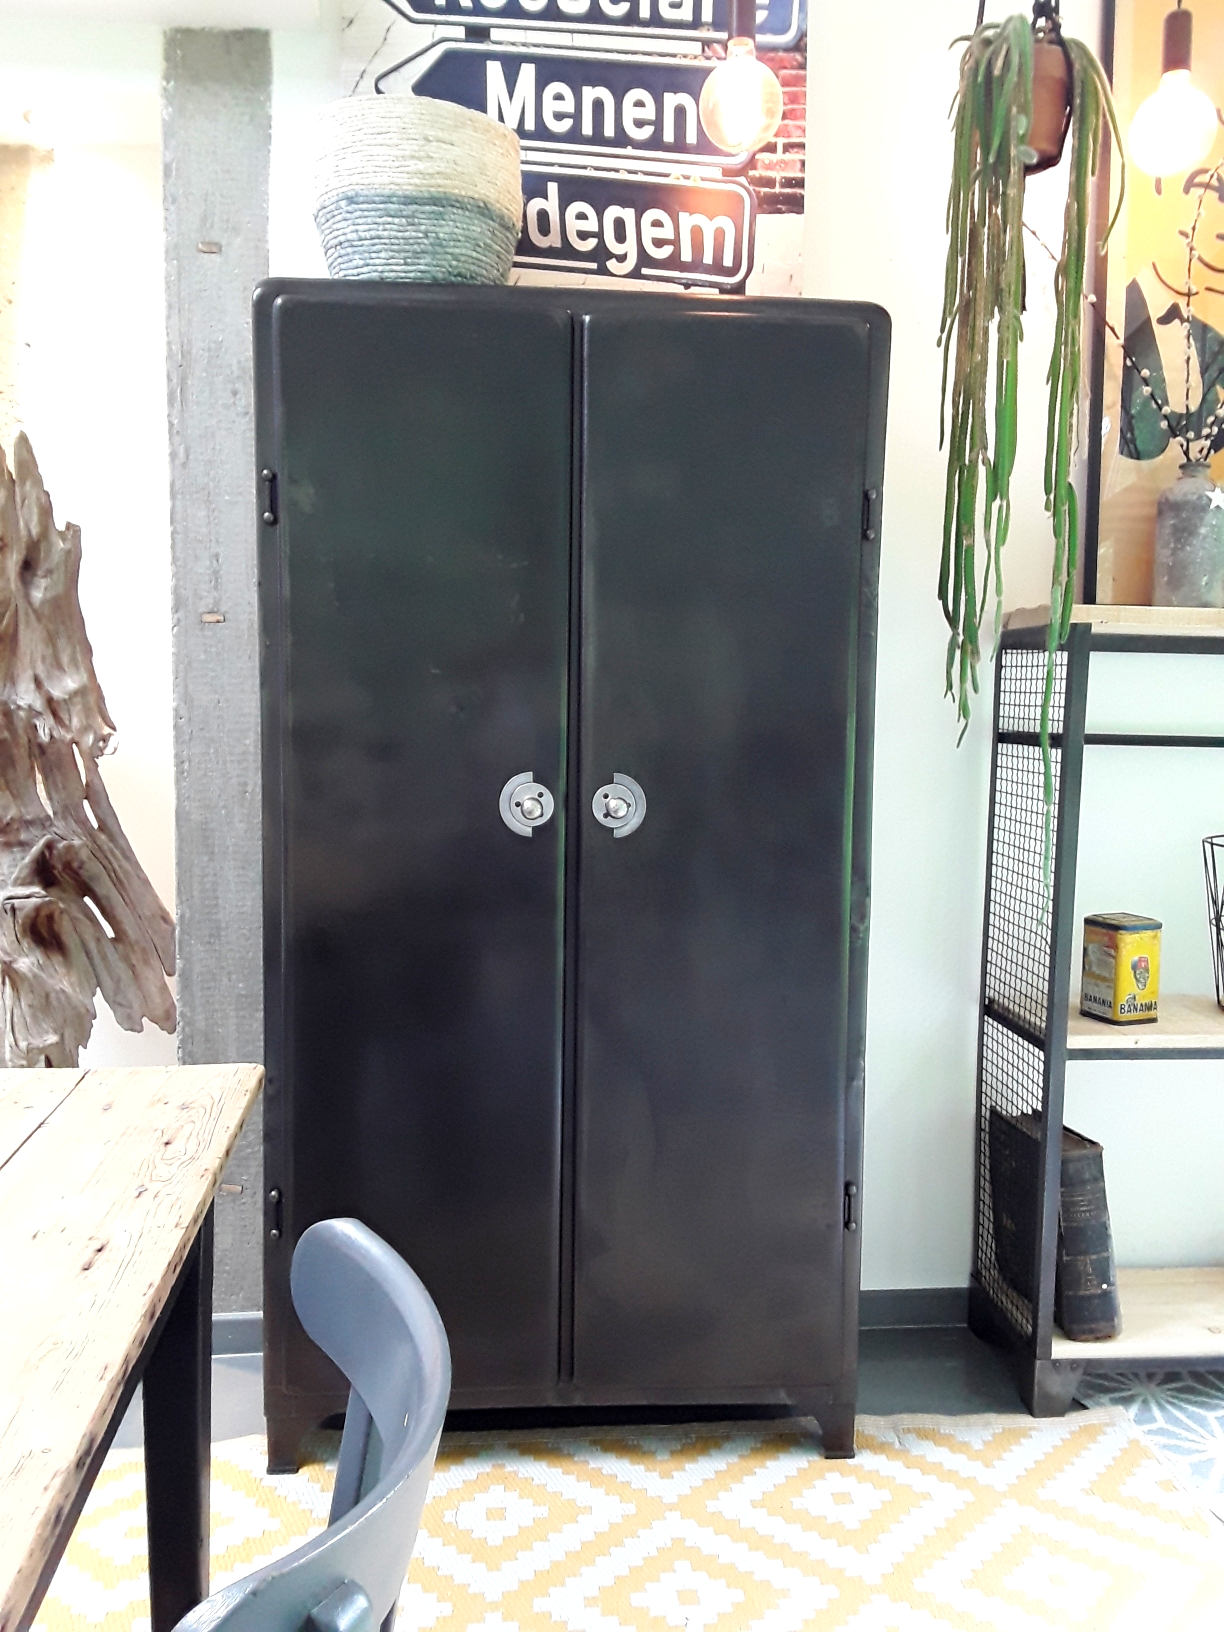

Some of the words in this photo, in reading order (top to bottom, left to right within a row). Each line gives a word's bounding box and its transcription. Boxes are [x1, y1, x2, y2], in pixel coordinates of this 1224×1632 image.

[486, 60, 698, 145] Menen
[526, 181, 736, 276] degem
[1084, 992, 1113, 1009] BANANIA
[1119, 999, 1158, 1015] BANANIA
